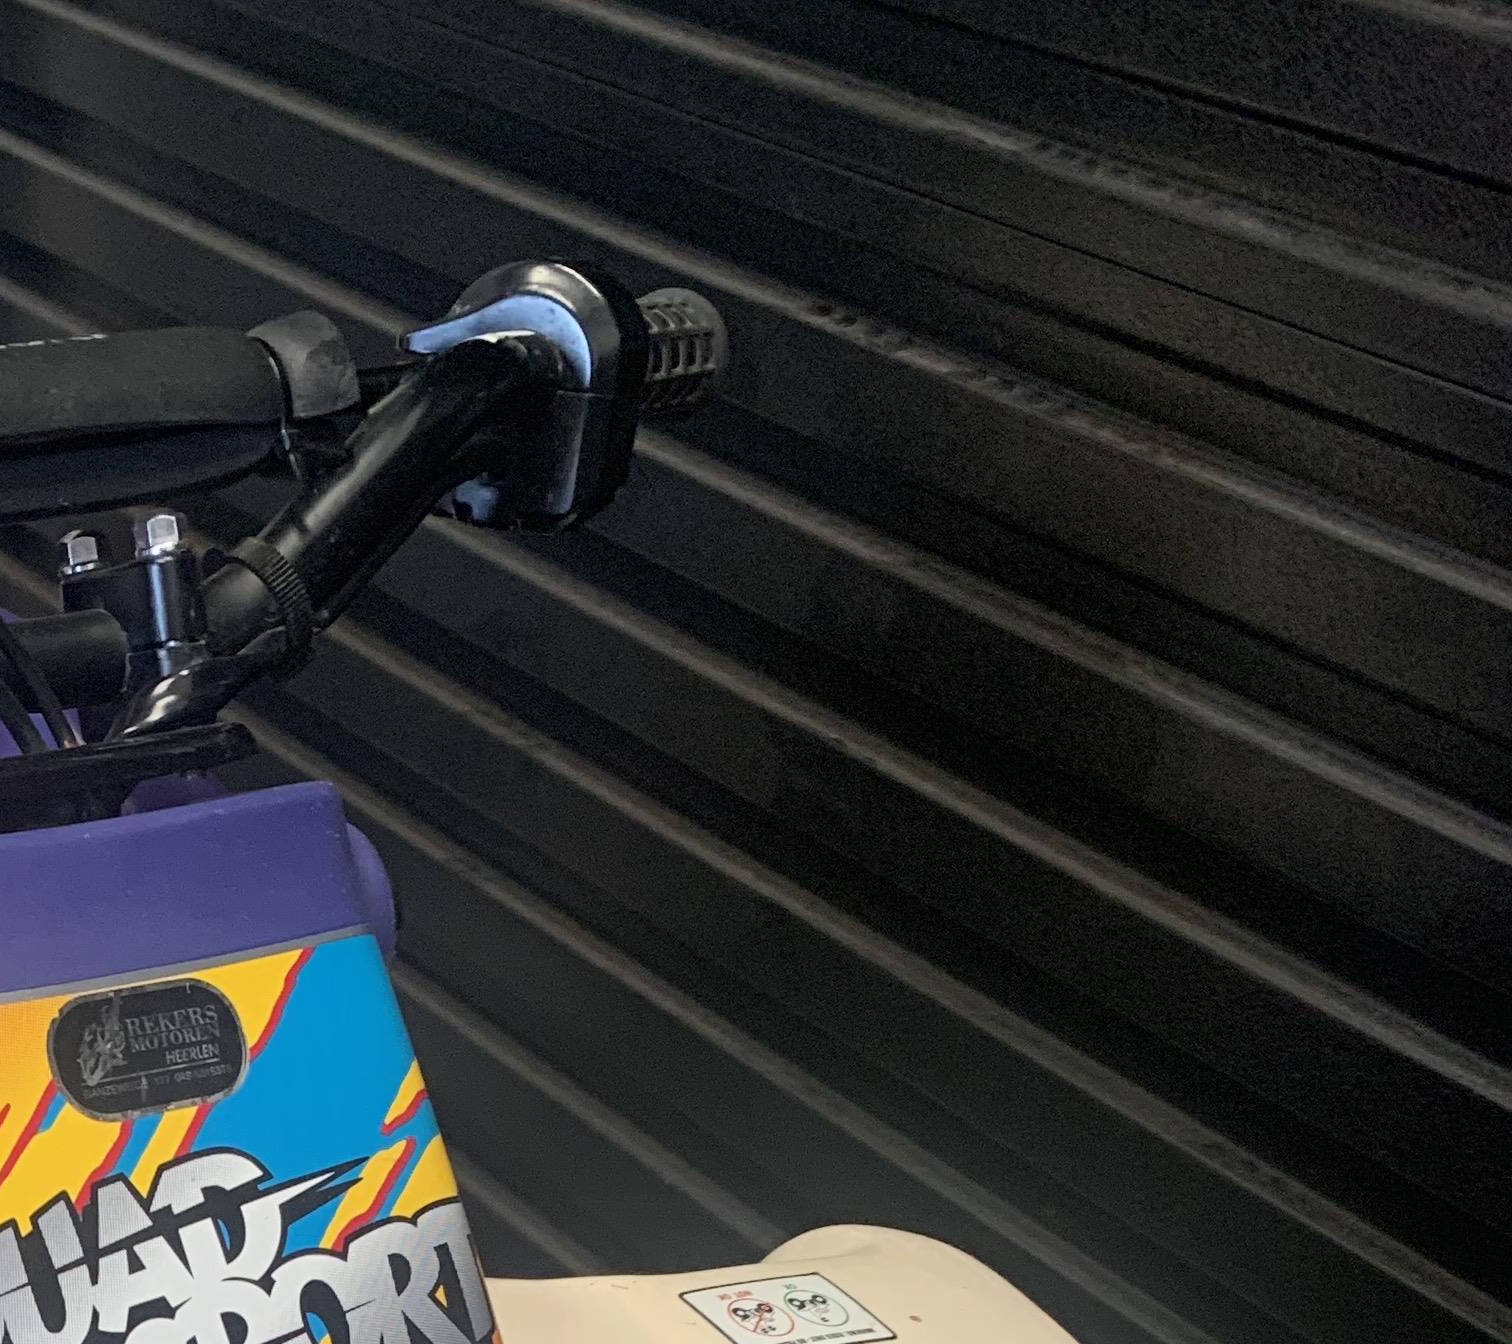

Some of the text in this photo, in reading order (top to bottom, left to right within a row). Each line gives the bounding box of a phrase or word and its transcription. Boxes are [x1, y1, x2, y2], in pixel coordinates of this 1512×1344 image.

[125, 1004, 219, 1036] REKERS
[129, 1022, 221, 1053] MOTOREN
[165, 1043, 221, 1065] HEERLEN
